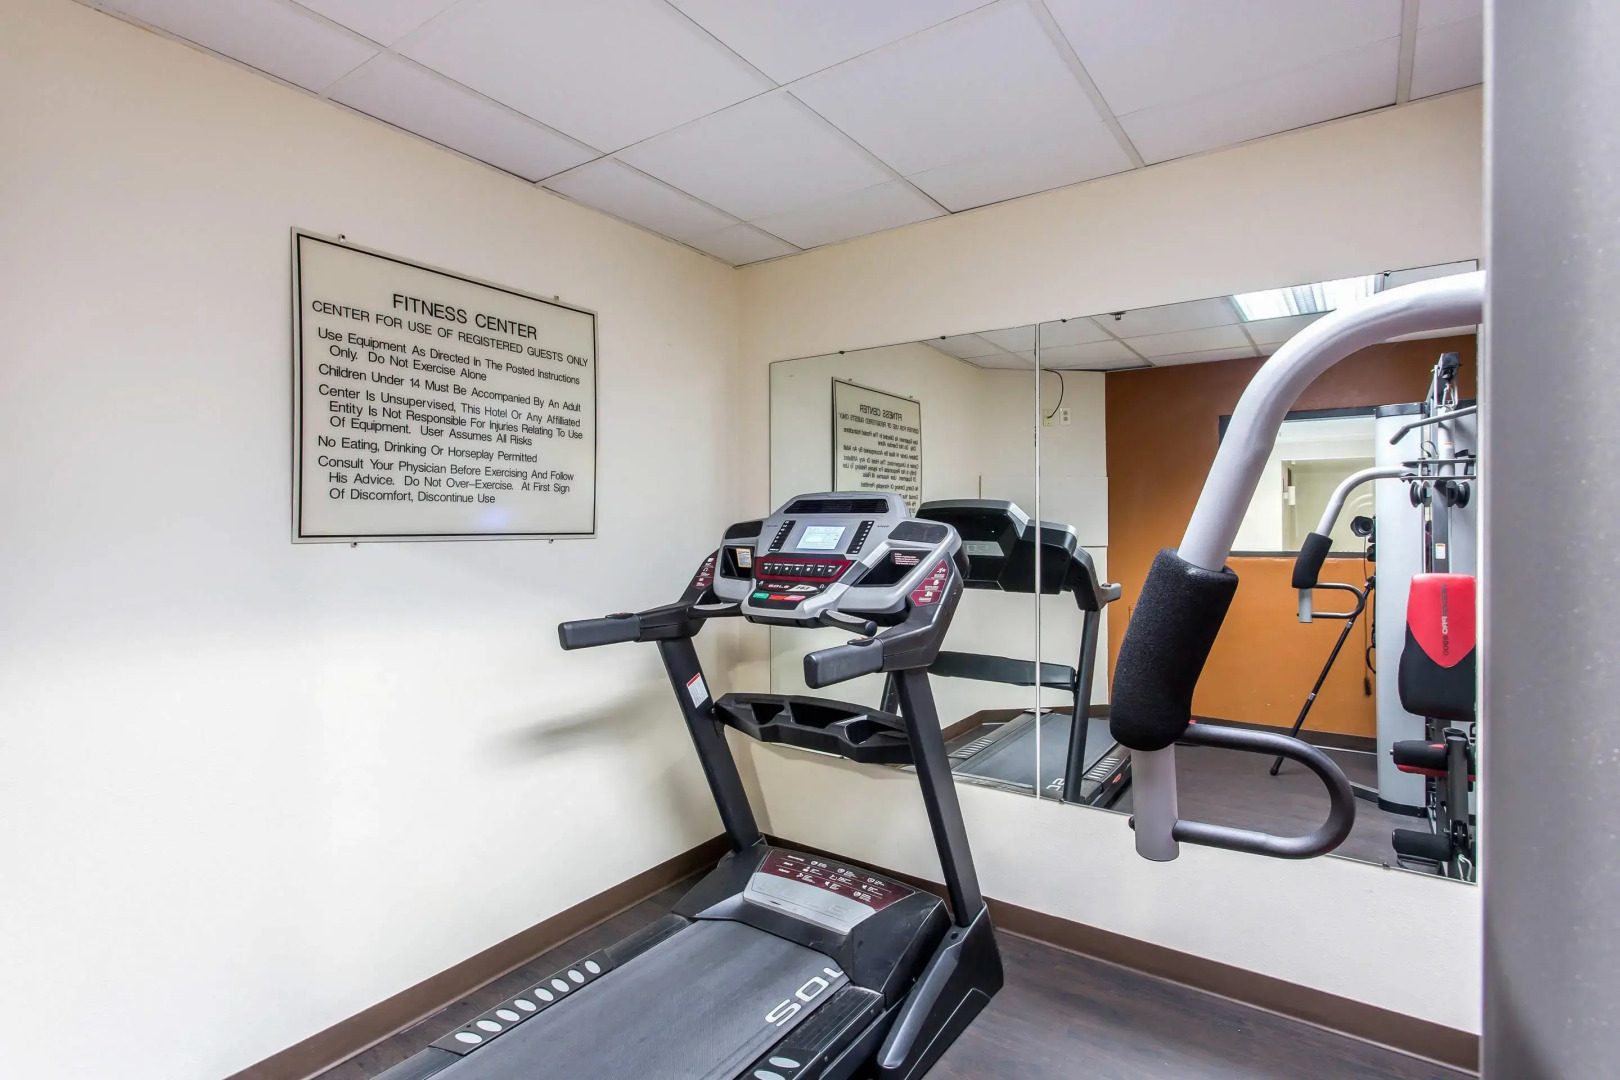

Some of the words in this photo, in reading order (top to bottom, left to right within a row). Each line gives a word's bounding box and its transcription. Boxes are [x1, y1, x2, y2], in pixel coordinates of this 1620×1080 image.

[312, 300, 370, 322] CENTER
[376, 313, 402, 329] FOR
[408, 320, 432, 335] USE
[437, 327, 453, 338] OF
[458, 331, 523, 353] REGISTERED
[527, 346, 563, 362] GUESTS
[567, 354, 588, 367] ONLY
[393, 293, 467, 324] FITNESS
[475, 313, 537, 340] CENTER
[318, 326, 342, 341] Use
[348, 332, 406, 353] Equipment
[412, 345, 426, 357] As
[430, 348, 469, 365] Directed
[473, 356, 481, 367] In
[485, 358, 502, 371] The
[506, 362, 534, 376] Posted
[537, 369, 580, 385] Instructions
[329, 345, 358, 361] Only.
[368, 351, 385, 364] Do
[390, 355, 408, 368] Not
[413, 359, 456, 375] Exercise
[460, 367, 487, 381] Alone
[318, 363, 366, 380] Children
[371, 371, 404, 386] Under
[410, 378, 420, 388] 14
[425, 379, 449, 392] Must
[453, 383, 467, 395] Be
[471, 387, 530, 404] Accompanied
[533, 396, 544, 408] By
[548, 399, 559, 409] An
[562, 401, 581, 412] Adult
[318, 384, 360, 399] Center
[366, 390, 375, 401] Is
[381, 392, 456, 413] Unsupervised,
[460, 402, 480, 415] This
[484, 406, 507, 418] Hotel
[511, 409, 522, 420] Or
[526, 412, 542, 424] Any
[329, 400, 363, 417] Entity
[368, 405, 378, 416] Is
[382, 407, 401, 419] Not
[406, 409, 466, 426] Responsible
[470, 417, 485, 428] For
[489, 420, 518, 433] Injuries
[521, 424, 553, 438] Relating
[556, 427, 565, 438] To
[568, 429, 583, 440] Use
[330, 415, 345, 427] Of
[351, 417, 411, 434] Equipment.
[420, 425, 444, 437] User
[449, 428, 492, 442] Assumes
[496, 433, 506, 443] All
[510, 434, 532, 446] Risks
[318, 435, 336, 447] No
[341, 437, 379, 452] Eating,
[384, 440, 426, 456] Drinking
[431, 445, 443, 455] Or
[448, 446, 494, 461] Horseplay
[497, 450, 537, 462] Permitted
[318, 455, 363, 469] Consult
[370, 459, 394, 470] Your
[399, 460, 446, 474] Physician
[450, 464, 481, 475] Before
[484, 466, 527, 480] Exercising
[531, 469, 547, 480] And
[550, 471, 574, 481] Follow
[329, 472, 347, 483] His
[354, 473, 394, 485] Advice.
[404, 475, 419, 486] Do
[424, 476, 441, 487] Not
[521, 481, 530, 491] At
[533, 482, 550, 492] First
[553, 483, 570, 494] Sign
[329, 487, 345, 499] Of
[350, 488, 413, 502] Discomfort,
[417, 490, 473, 502] Discontinue
[477, 493, 495, 503] Use
